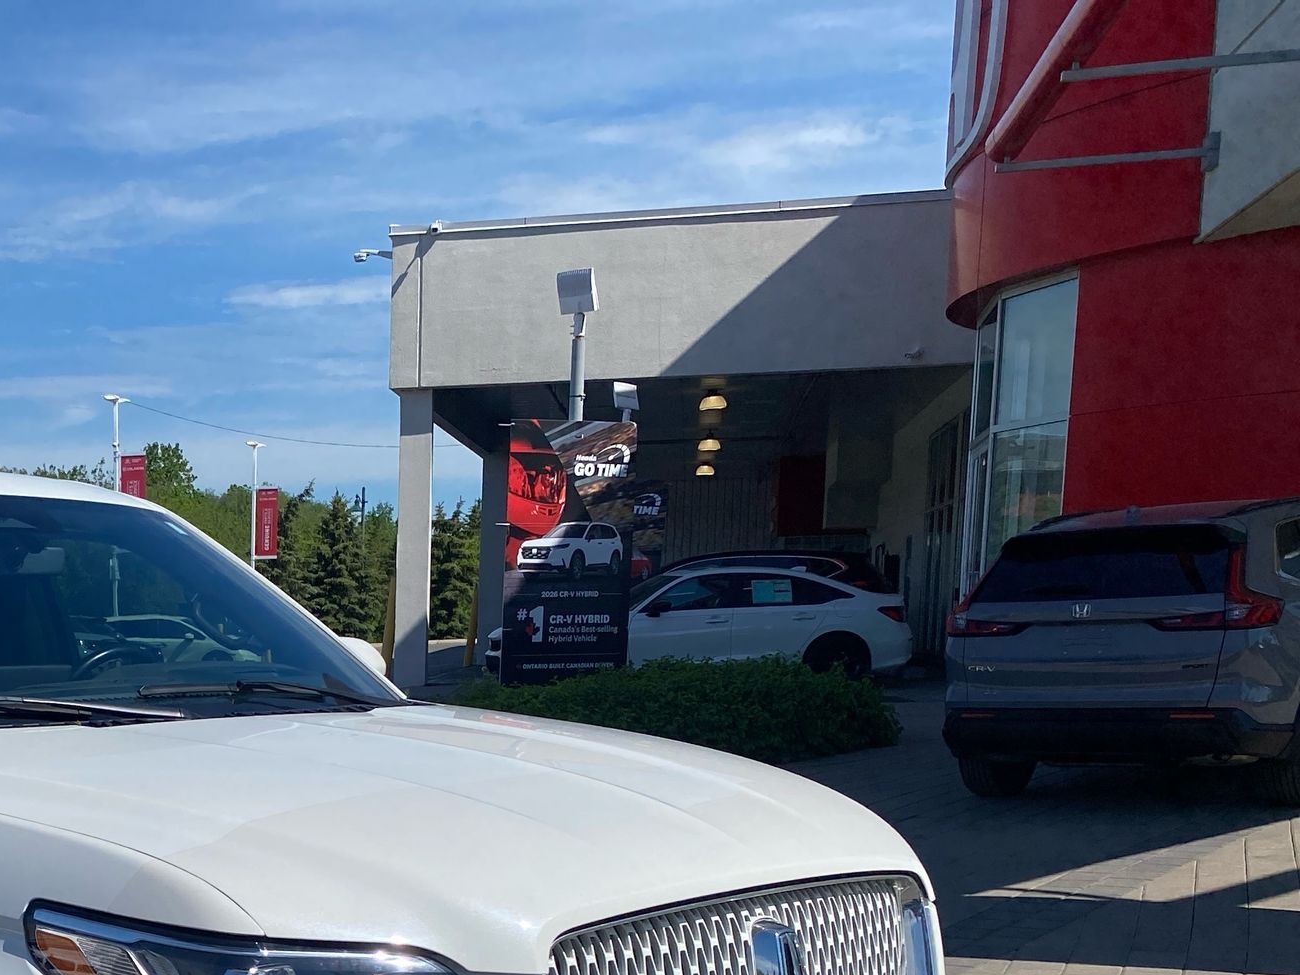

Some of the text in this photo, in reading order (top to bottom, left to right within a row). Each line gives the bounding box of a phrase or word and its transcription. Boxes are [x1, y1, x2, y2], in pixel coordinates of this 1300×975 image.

[576, 454, 597, 462] Honda
[574, 463, 629, 477] GO TIME
[633, 505, 660, 515] TIME
[559, 590, 575, 598] CR-V
[576, 590, 600, 598] HYBRID
[549, 614, 610, 624] CR-V HYBRID
[548, 625, 619, 634] Canada's Best-selling
[548, 634, 597, 644] Hybrid Vehicle
